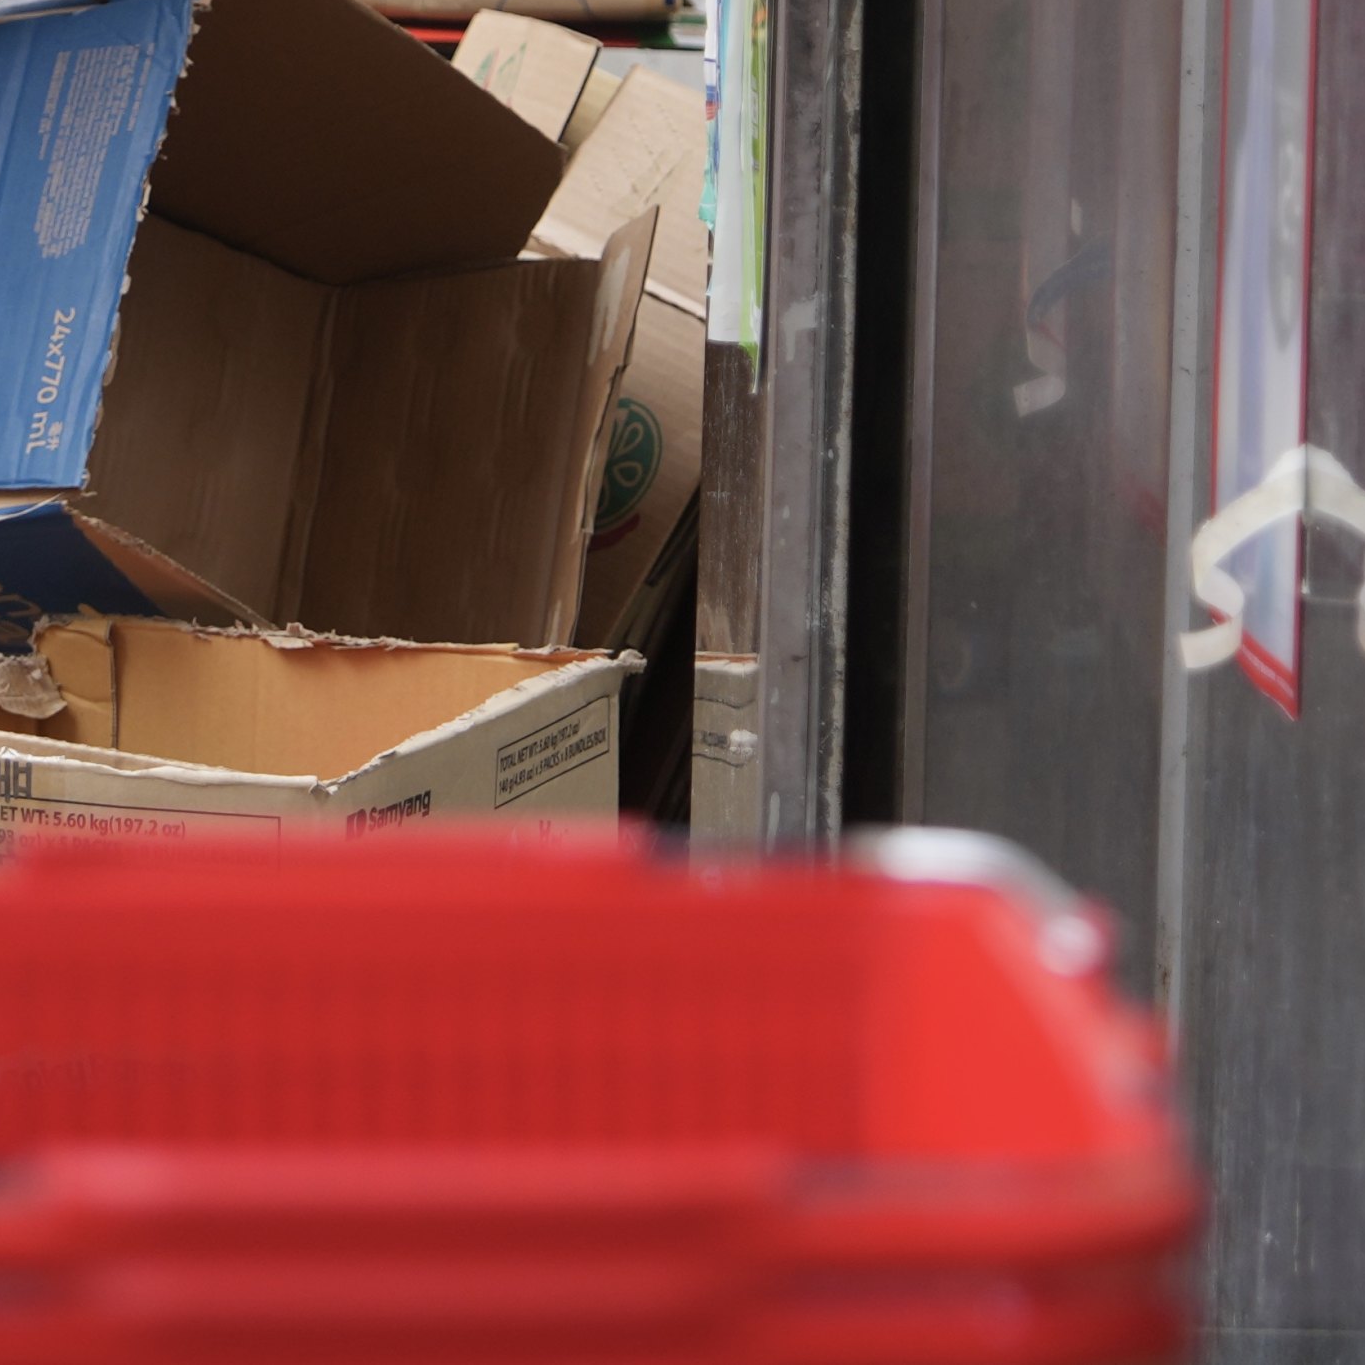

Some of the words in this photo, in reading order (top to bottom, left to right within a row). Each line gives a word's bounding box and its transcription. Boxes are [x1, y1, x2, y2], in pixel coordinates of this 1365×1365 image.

[34, 308, 75, 405] 24x770
[25, 410, 49, 454] mL
[21, 807, 50, 826] WT:
[53, 810, 86, 830] 5.60
[89, 812, 158, 836] kg(197.2
[368, 789, 432, 832] Samyang
